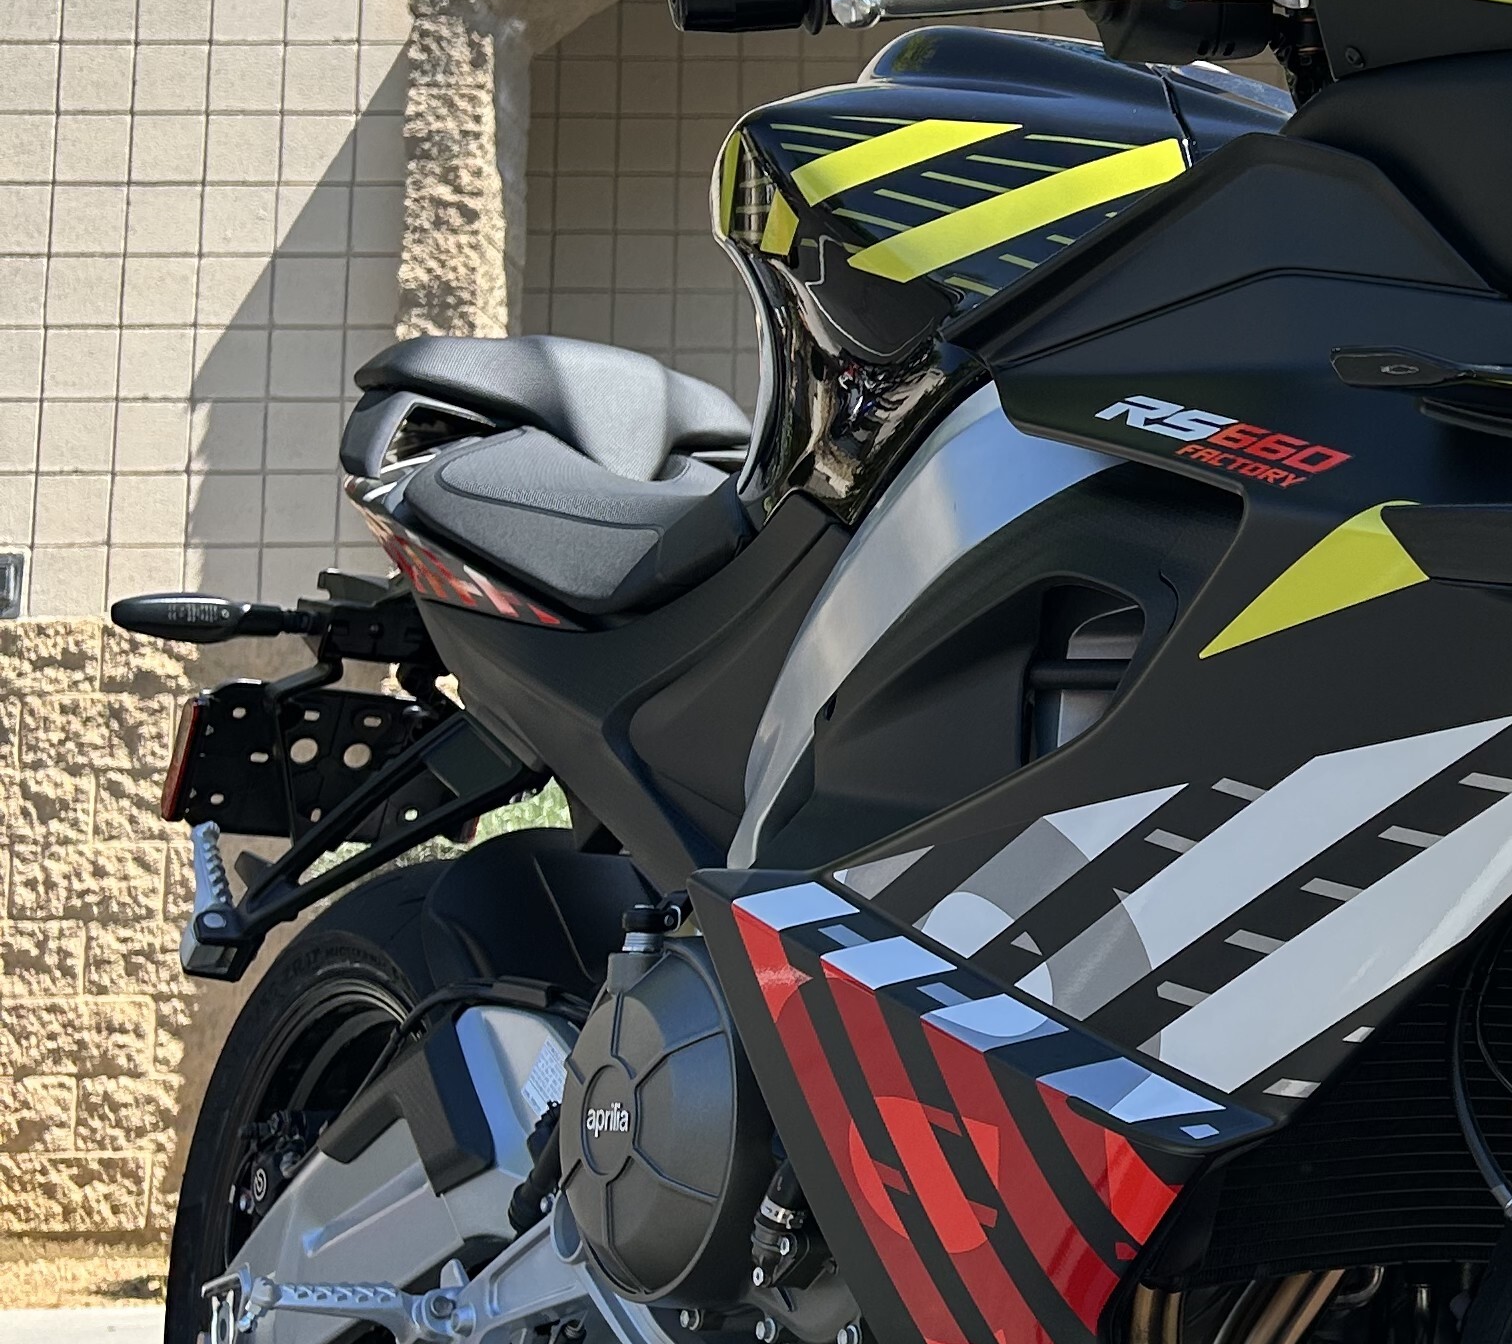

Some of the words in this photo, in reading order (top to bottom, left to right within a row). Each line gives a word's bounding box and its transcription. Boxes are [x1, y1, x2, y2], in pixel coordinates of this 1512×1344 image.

[1093, 394, 1352, 474] RS660
[1174, 443, 1307, 489] FACTORY
[585, 1102, 630, 1138] aprilia
